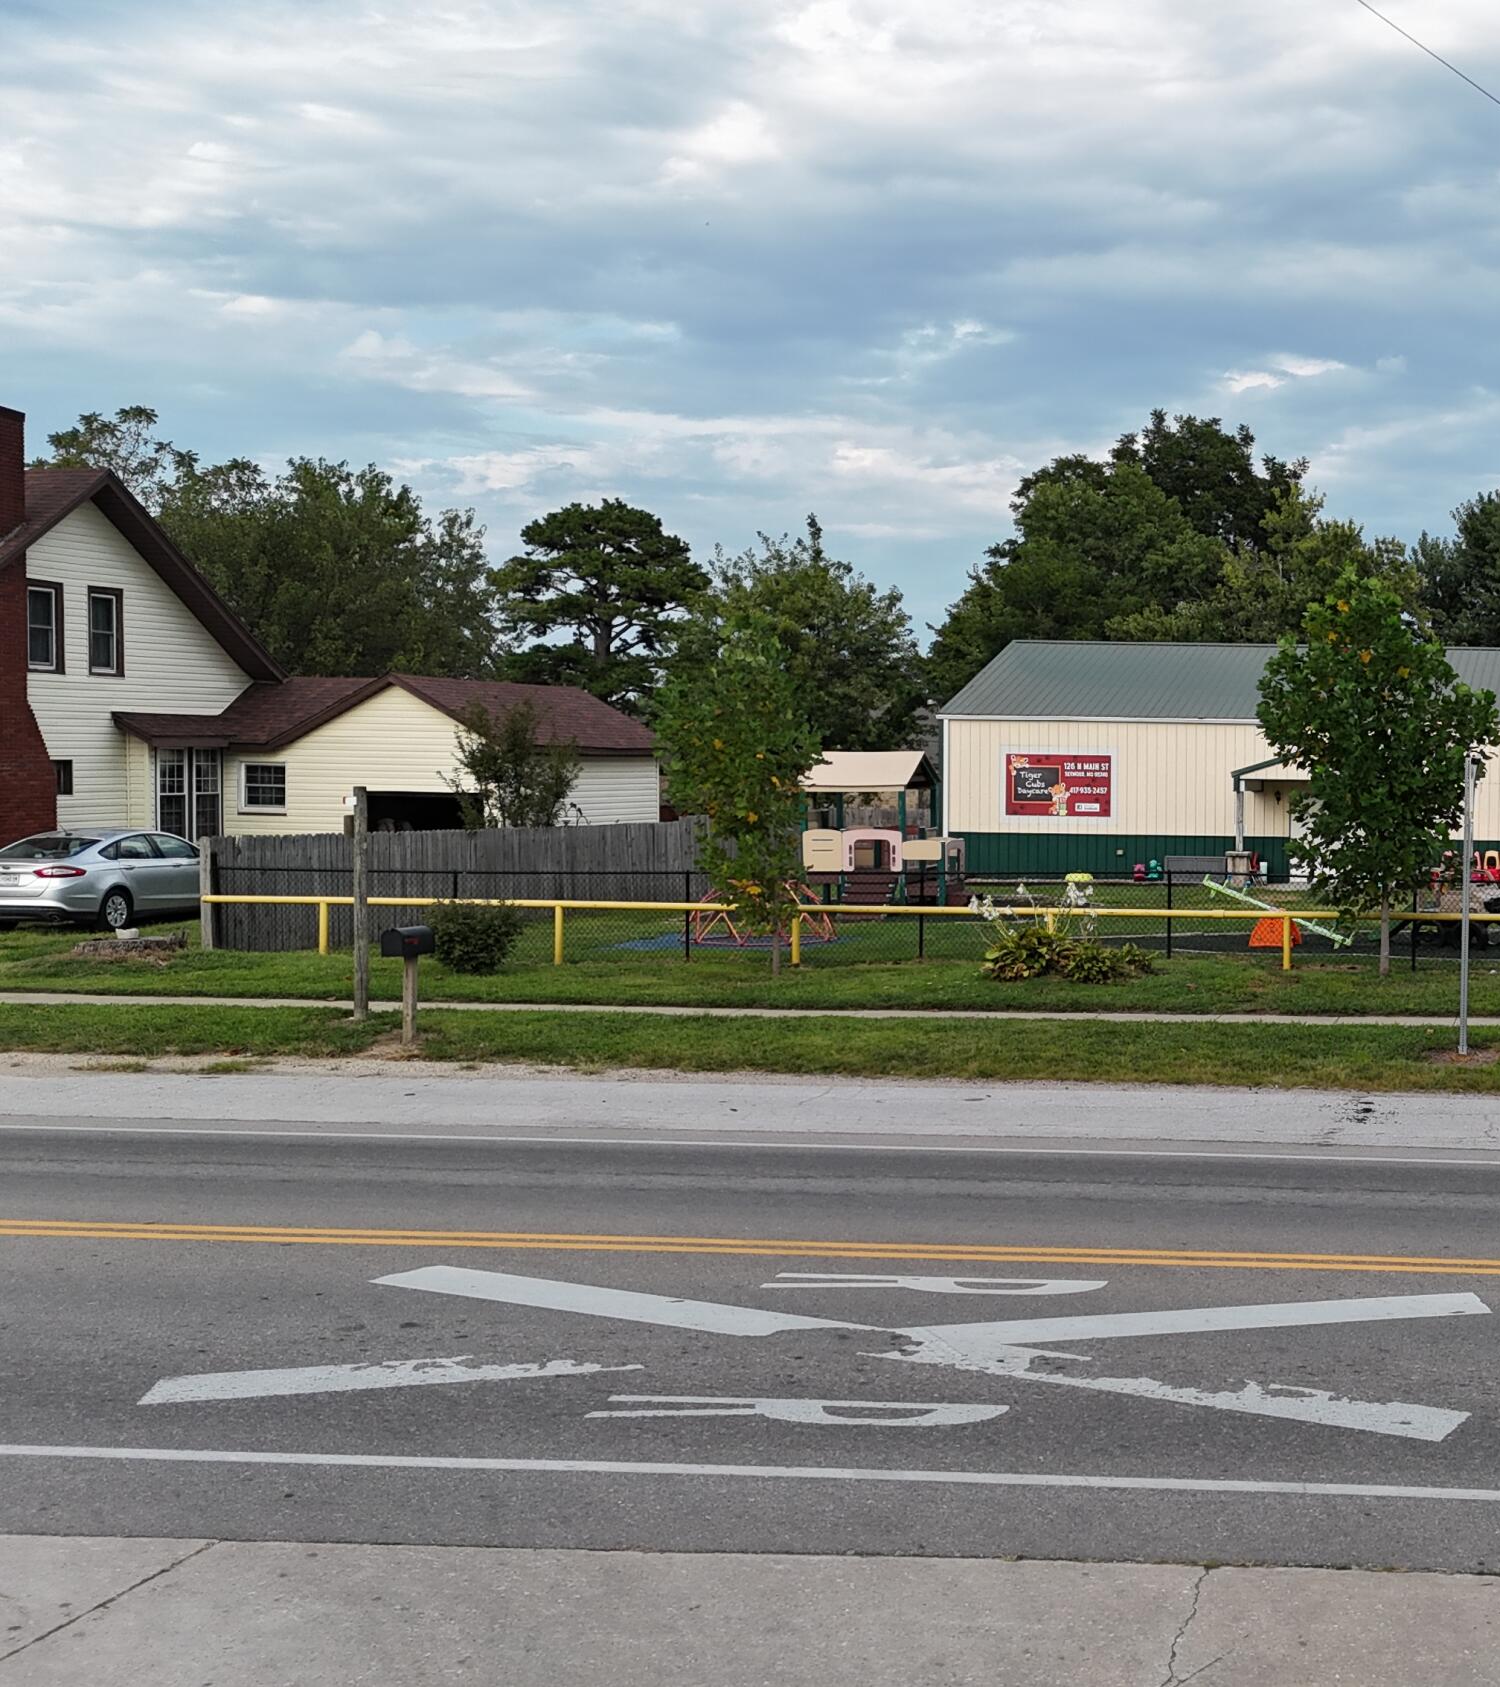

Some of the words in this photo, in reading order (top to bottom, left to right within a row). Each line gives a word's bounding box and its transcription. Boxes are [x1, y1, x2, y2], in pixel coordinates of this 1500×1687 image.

[1064, 762, 1075, 770] 126
[1101, 763, 1109, 771] ST
[1020, 771, 1042, 780] Tiger
[1025, 780, 1046, 788] Cubs
[1017, 787, 1049, 797] Daycare
